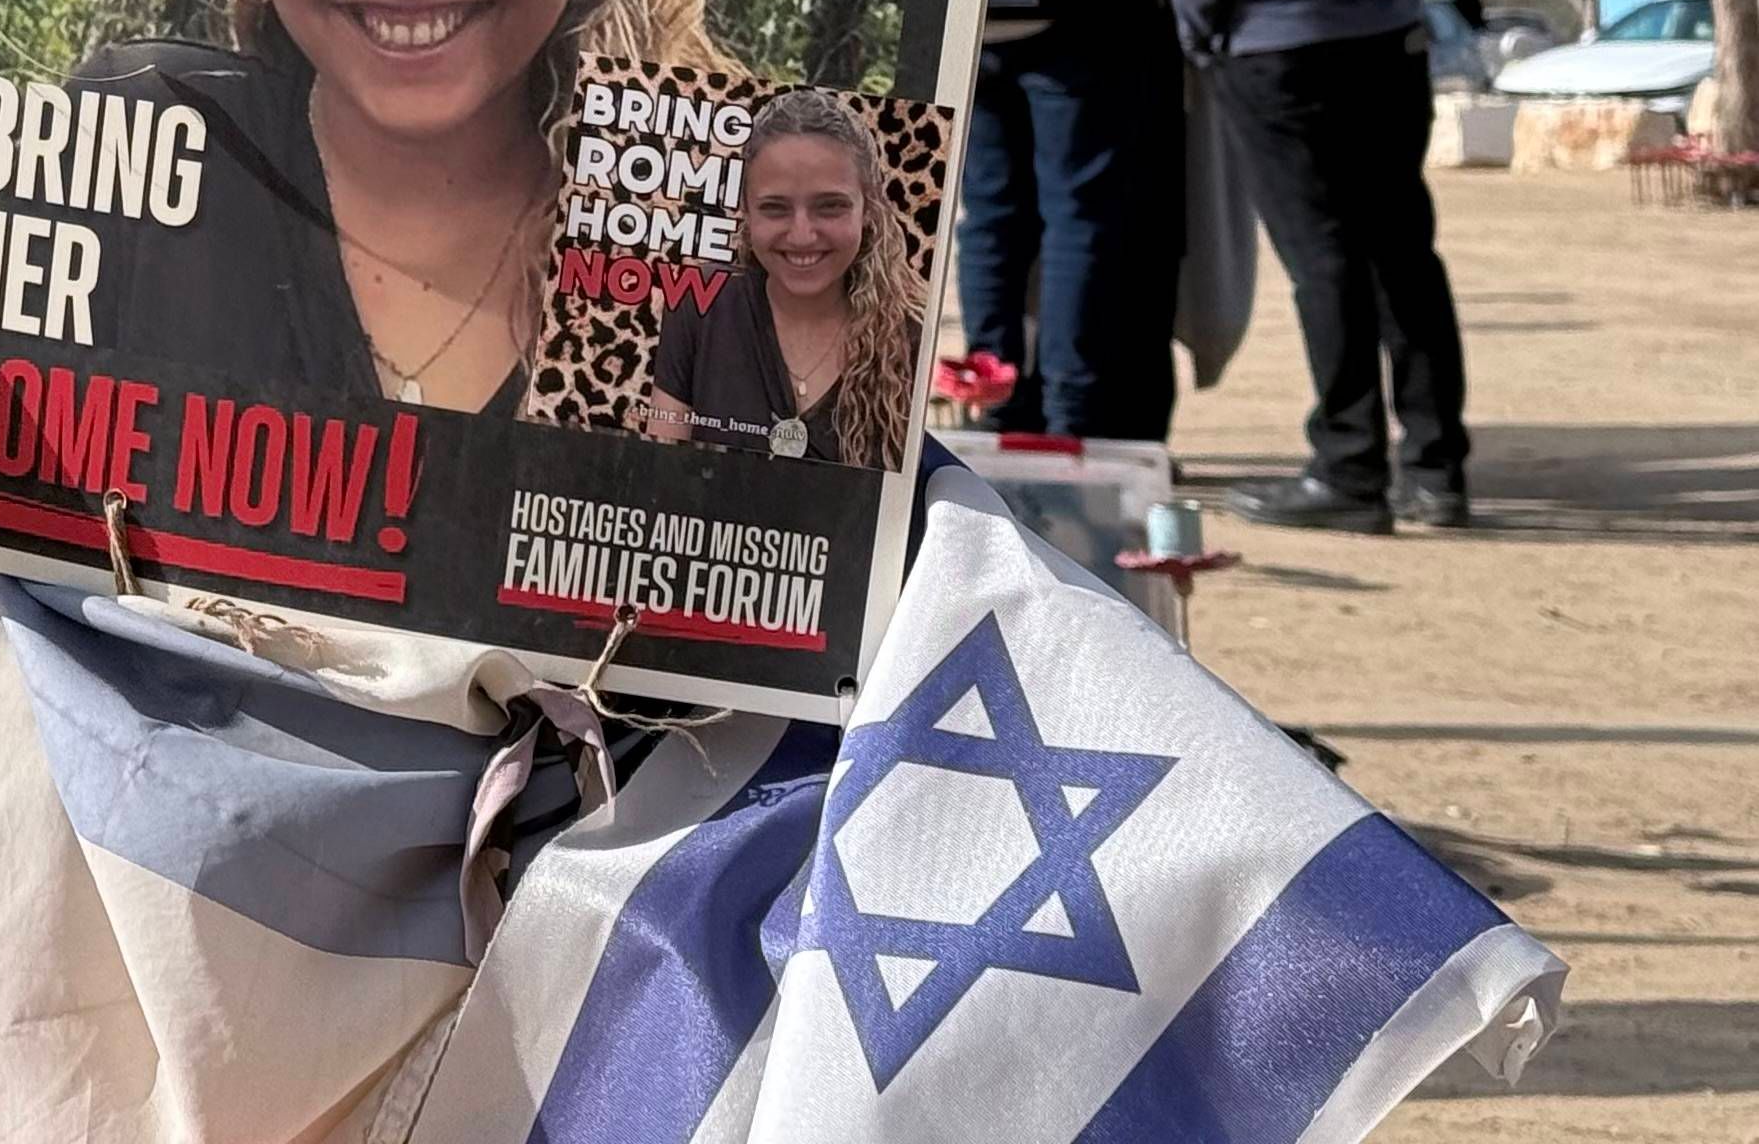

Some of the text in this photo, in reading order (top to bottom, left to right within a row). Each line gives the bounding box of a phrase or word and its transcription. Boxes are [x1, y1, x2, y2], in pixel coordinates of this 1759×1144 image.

[582, 84, 754, 146] BRING
[573, 135, 745, 210] ROMI
[565, 197, 740, 262] HOME
[558, 247, 729, 317] NOW
[173, 392, 420, 554] NOW!
[511, 490, 830, 578] HOSTAGES AND MISSING
[503, 533, 826, 637] FAMILIES FORUM
